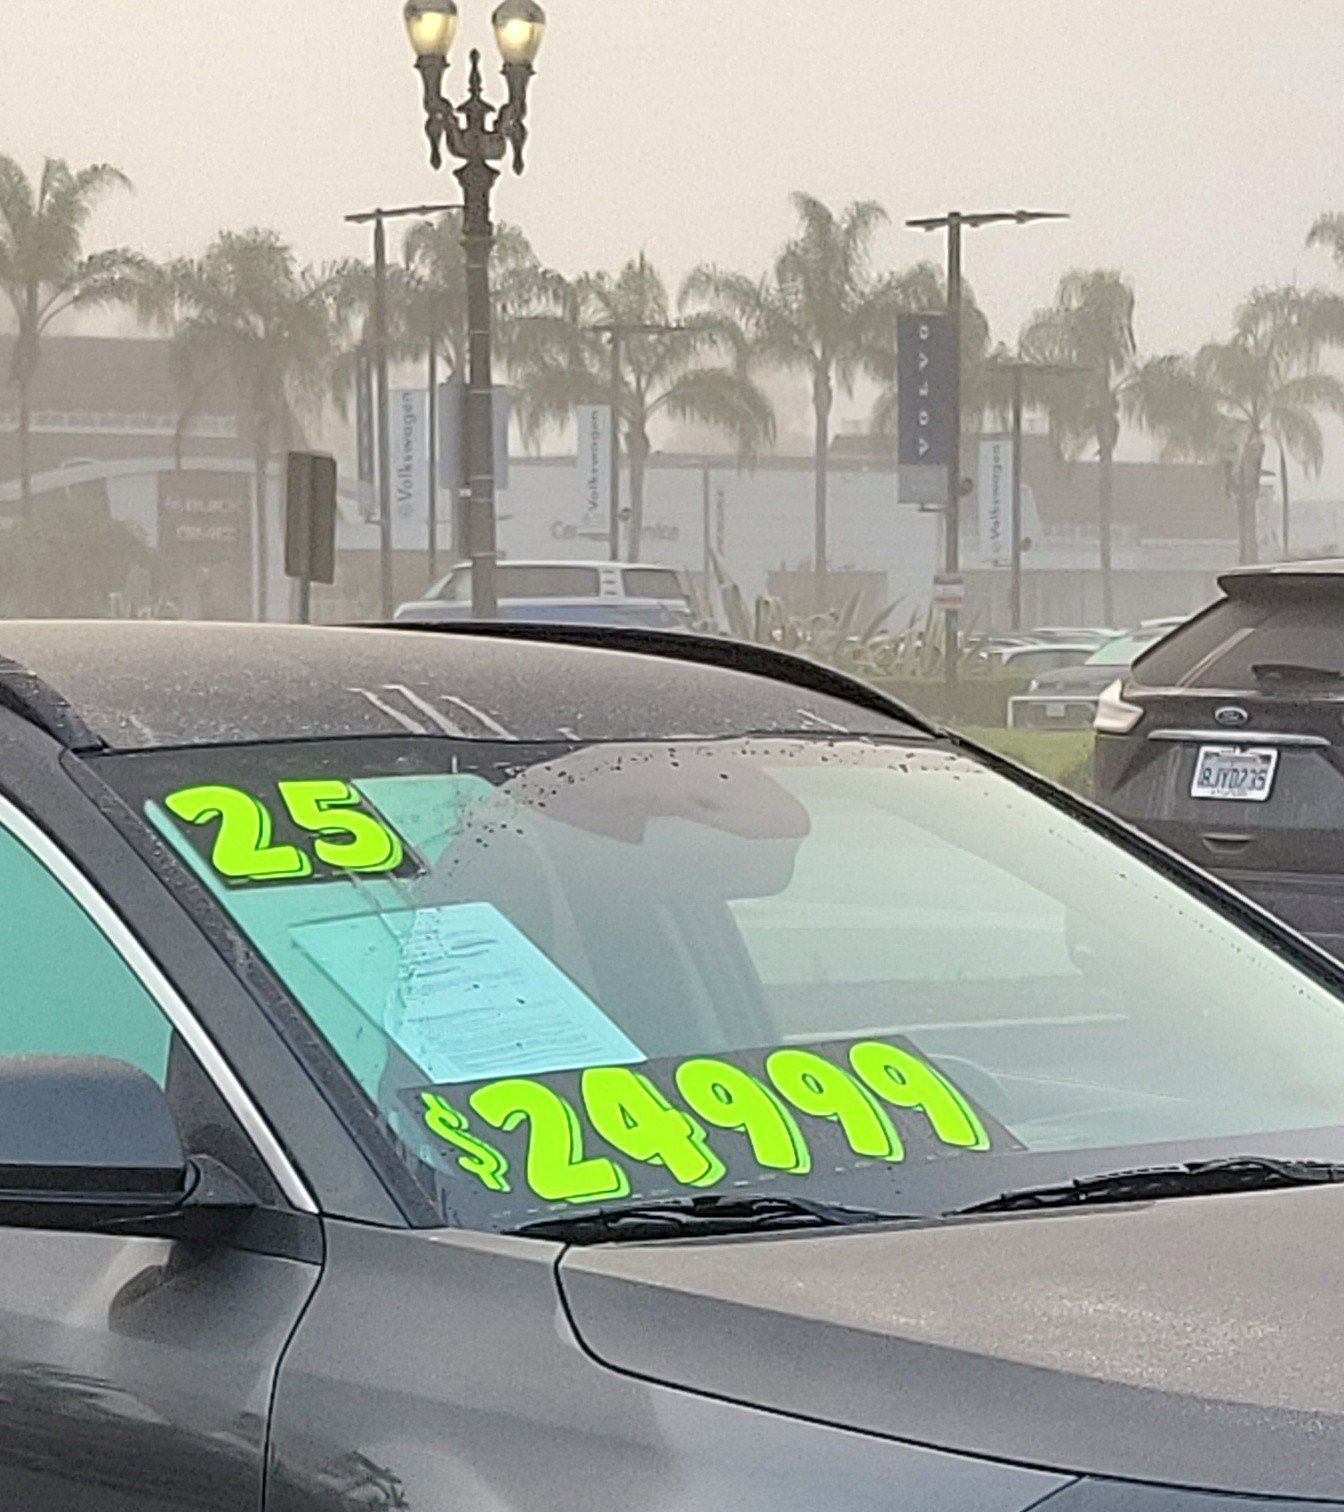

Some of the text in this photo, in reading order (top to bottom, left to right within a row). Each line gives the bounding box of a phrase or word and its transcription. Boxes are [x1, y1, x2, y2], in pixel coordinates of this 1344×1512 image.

[396, 391, 418, 503] Volkswagen
[918, 324, 931, 457] VOLVO
[165, 779, 406, 880] 25
[420, 1041, 989, 1203] $24999
